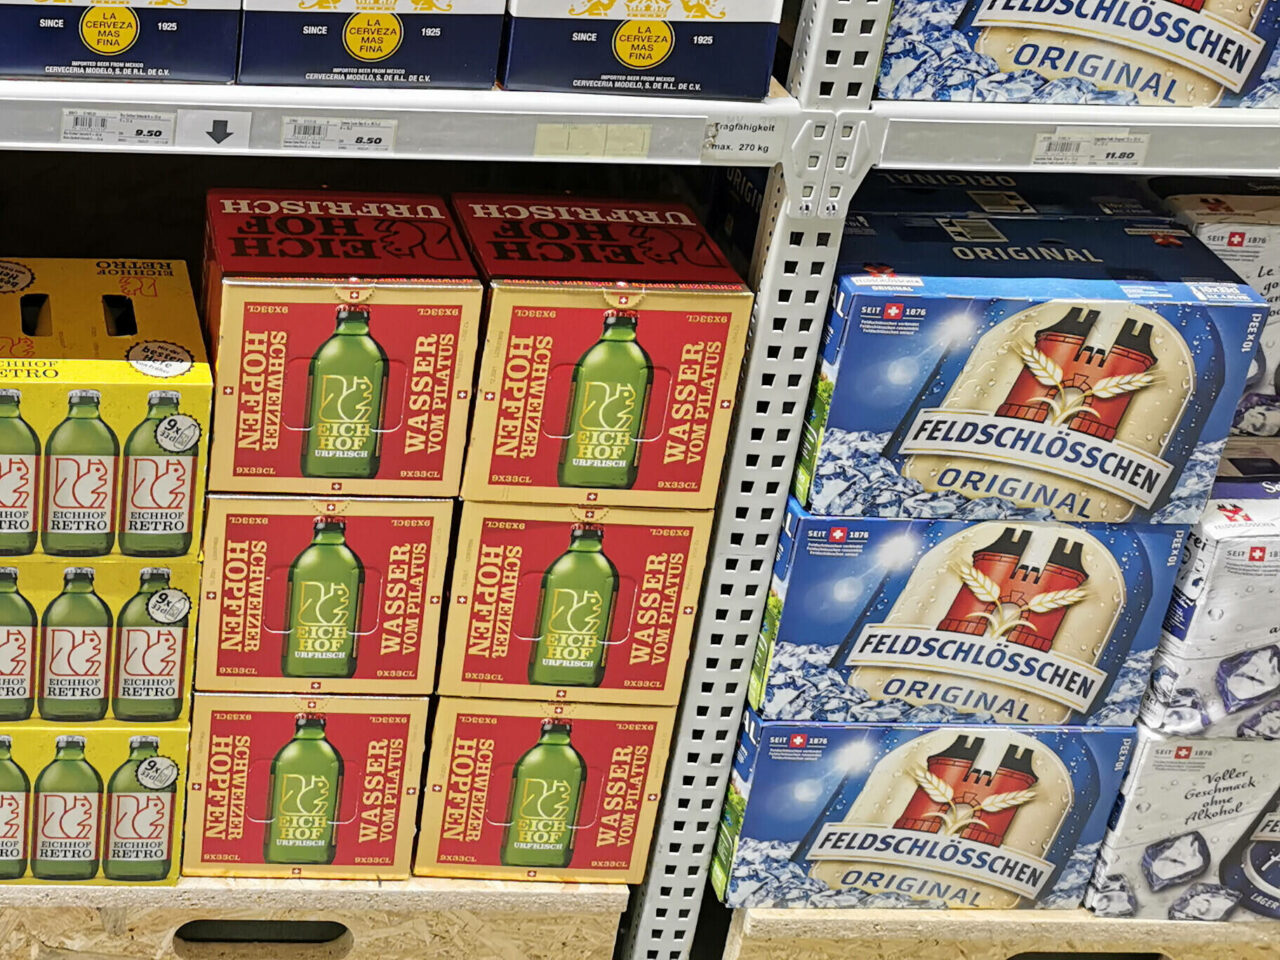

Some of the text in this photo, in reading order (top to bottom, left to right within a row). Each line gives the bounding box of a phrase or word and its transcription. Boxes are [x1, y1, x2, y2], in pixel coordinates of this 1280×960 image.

[40, 19, 64, 28] SINCE
[85, 21, 133, 29] CERVEZA
[157, 22, 177, 31] 1925
[97, 38, 120, 46] FINA
[1013, 43, 1177, 104] ORIGINAL
[135, 129, 162, 138] 9.50
[758, 144, 768, 153] kg
[1105, 151, 1135, 159] 11.80
[237, 330, 268, 451] HOPFEN
[262, 330, 287, 451] SCHWEIZER
[404, 333, 438, 455] WASSER
[427, 332, 455, 454] VOM PILATUS
[318, 422, 370, 437] EICH
[314, 449, 368, 458] URFRISCH
[319, 437, 366, 450] HOF
[913, 418, 1161, 494] FELDSCHLÖSSCHEN
[937, 468, 1092, 518] ORIGINAL
[859, 631, 1096, 699] FELDSCHLÖSSCHEN
[882, 678, 1030, 722] ORIGINAL
[1204, 768, 1248, 785] Voller
[1184, 779, 1256, 802] Geschmack
[1202, 794, 1234, 808] ohne
[1185, 803, 1243, 825] Alkohol
[819, 831, 1044, 888] FELDSCHLÖSSCHEN
[841, 870, 980, 908] ORIGINAL
